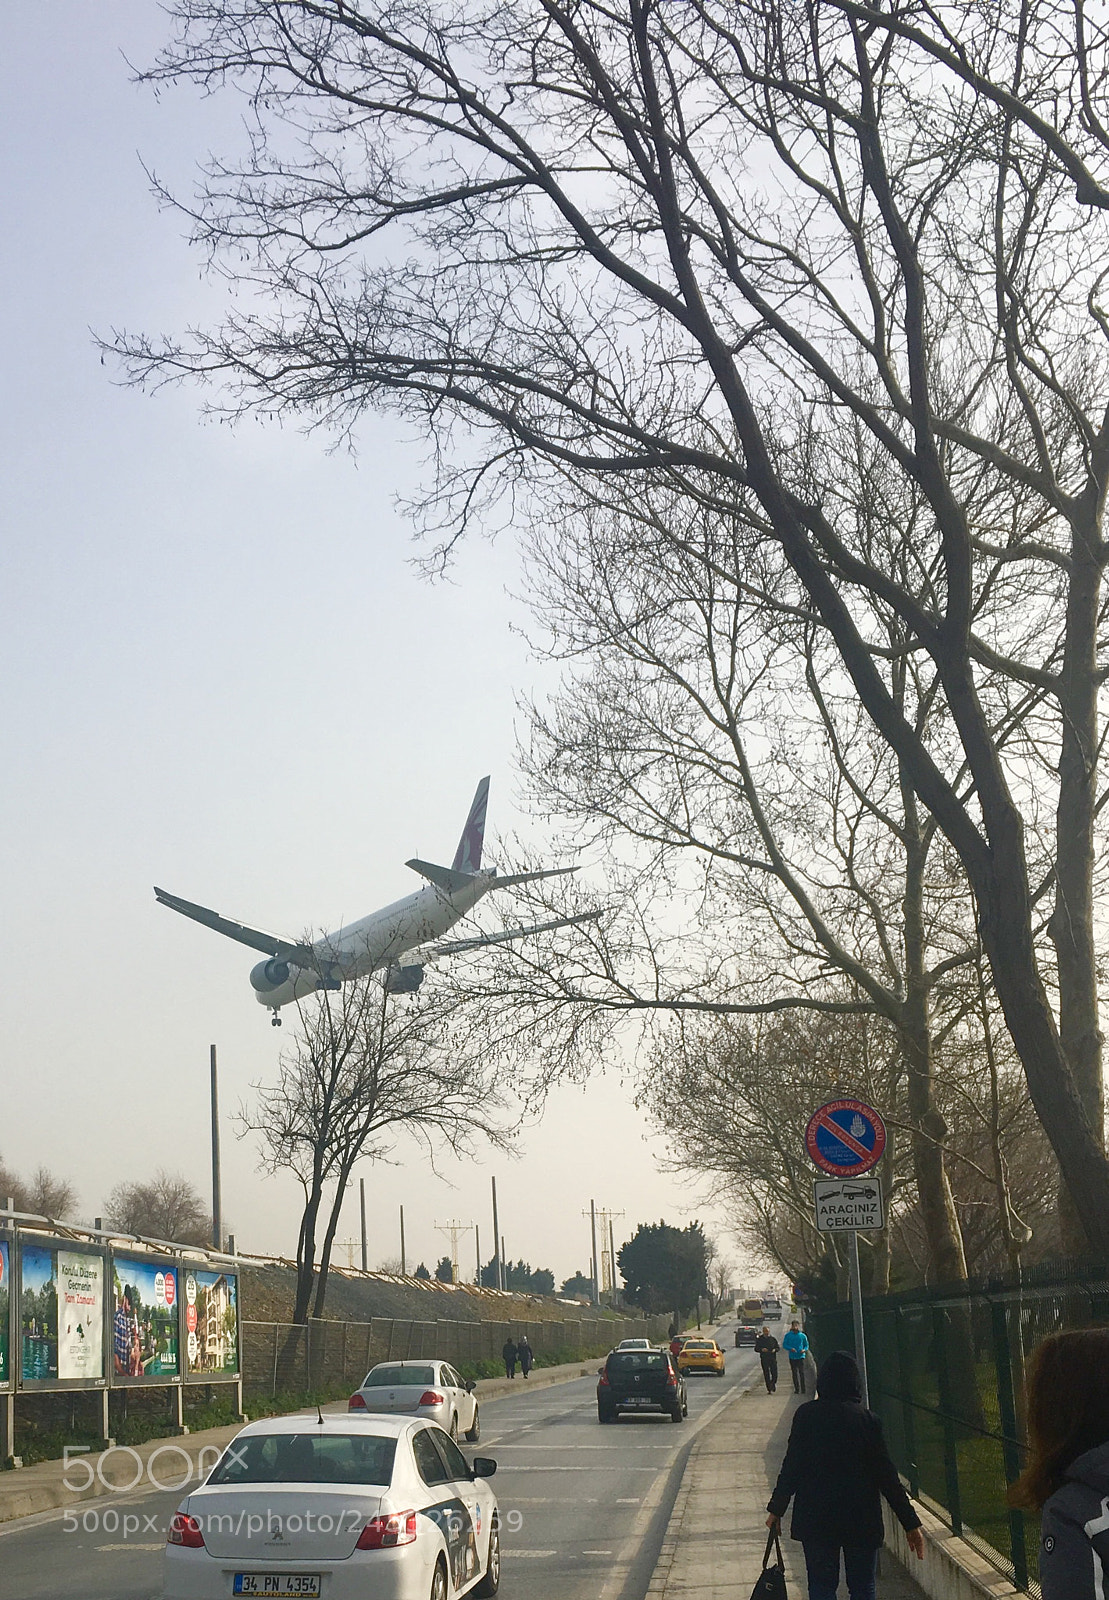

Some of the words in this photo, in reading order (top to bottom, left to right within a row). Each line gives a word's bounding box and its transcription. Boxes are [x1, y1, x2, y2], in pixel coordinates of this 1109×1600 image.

[808, 1110, 827, 1141] DERECE
[874, 1120, 883, 1141] YOLU
[819, 1158, 837, 1172] PARK
[840, 1156, 876, 1174] YAPILMAZ
[820, 1203, 878, 1215] ARACINIZ
[826, 1214, 874, 1228] ÇEKİLİR
[243, 1576, 258, 1591] 34
[264, 1577, 280, 1592] PN
[286, 1577, 317, 1592] 4354
